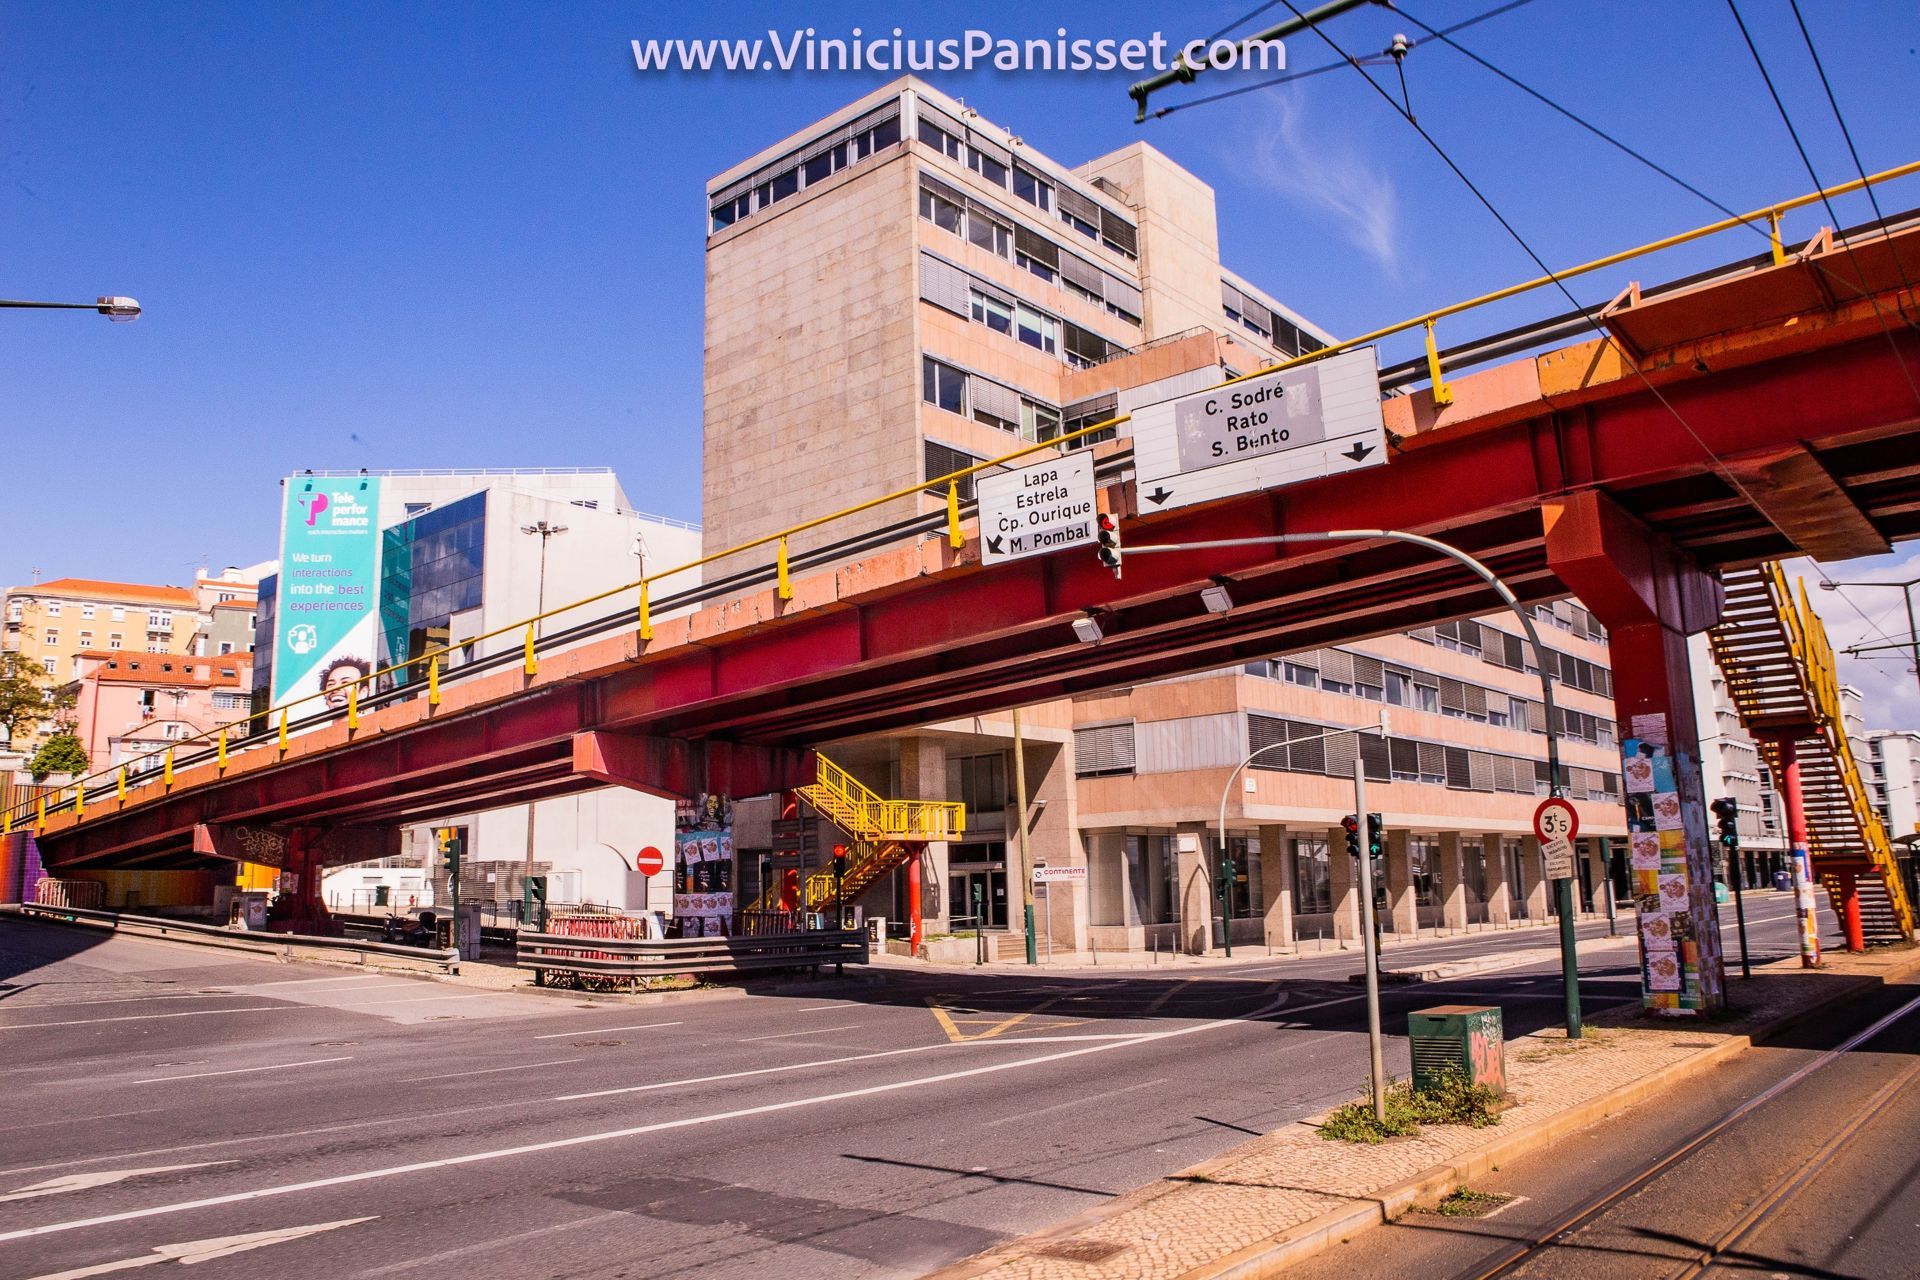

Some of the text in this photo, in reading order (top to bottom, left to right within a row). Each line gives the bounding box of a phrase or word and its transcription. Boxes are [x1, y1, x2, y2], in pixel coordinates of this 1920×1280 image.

[1205, 382, 1284, 416] C. Sodré
[1227, 411, 1269, 432] Rato
[1211, 428, 1290, 457] S. Bento
[1024, 470, 1058, 488] Lapa
[332, 491, 354, 504] Tele
[1016, 486, 1068, 509] Estrela
[332, 503, 368, 517] perfor
[998, 502, 1091, 532] Cp. Ourique
[332, 517, 369, 526] mance
[1010, 523, 1090, 553] M. Pombal
[292, 553, 333, 563] We turn
[292, 567, 353, 578] interactions
[290, 582, 365, 595] into the best
[290, 601, 364, 613] experiences
